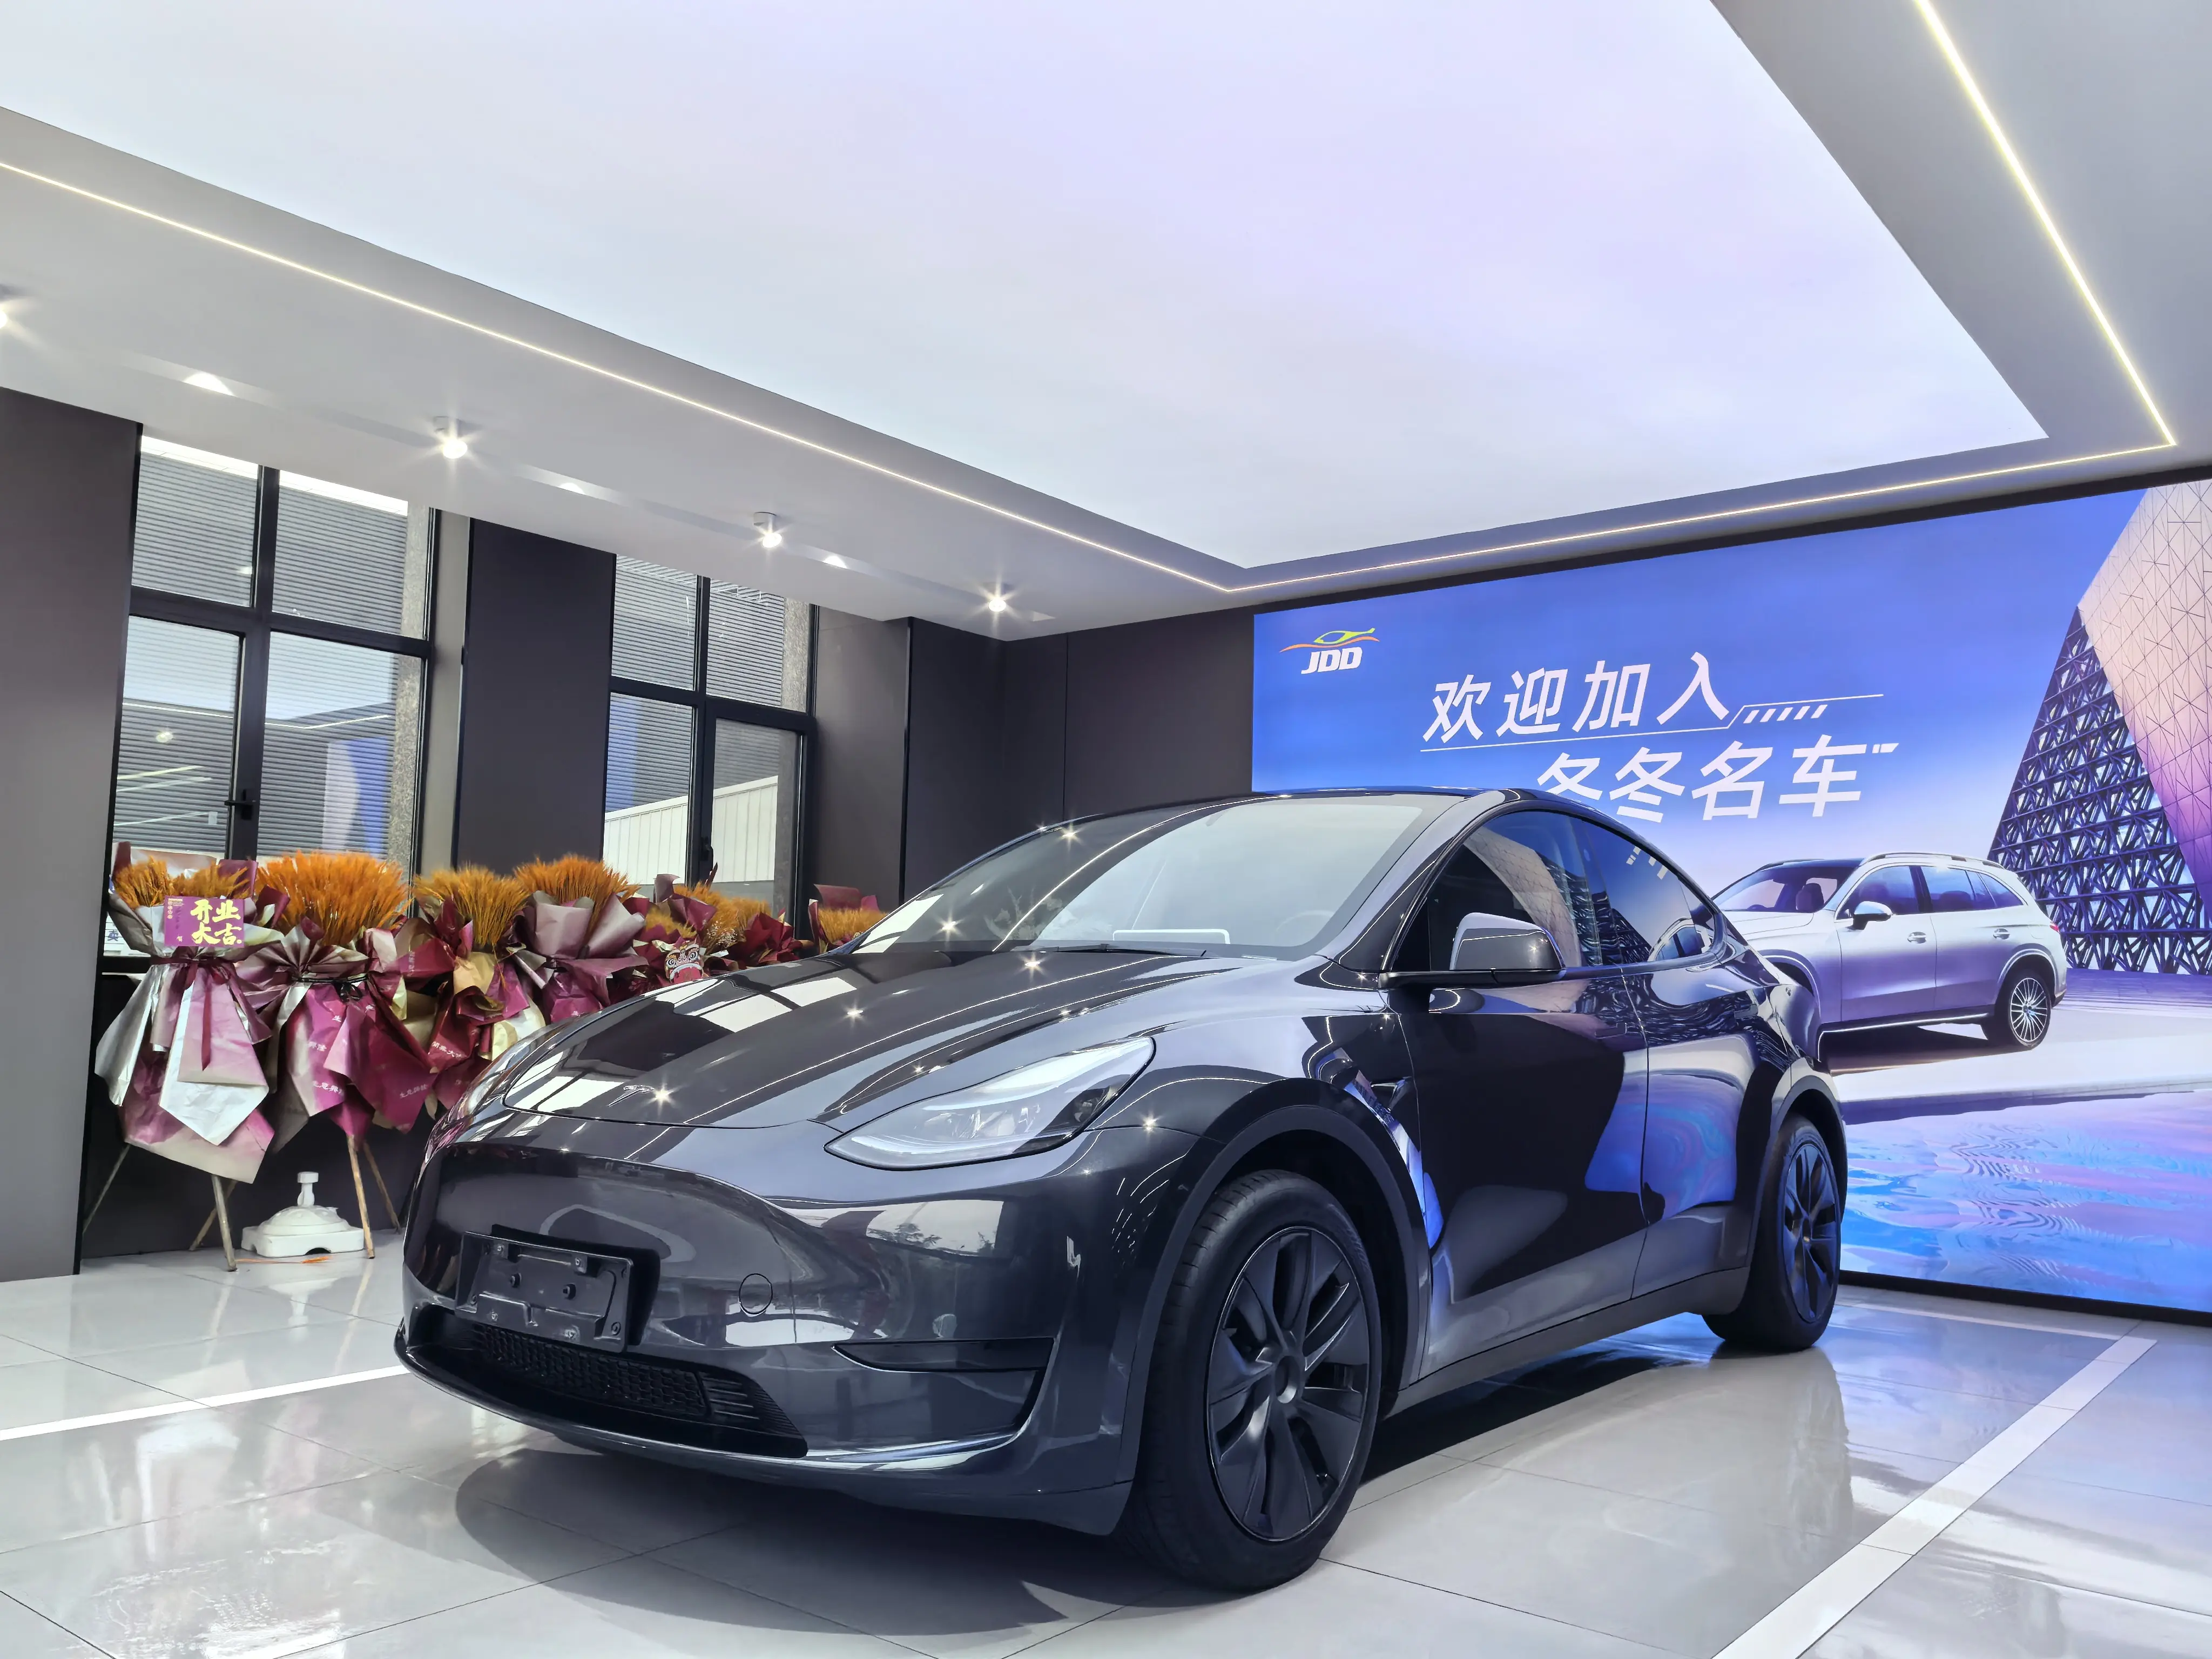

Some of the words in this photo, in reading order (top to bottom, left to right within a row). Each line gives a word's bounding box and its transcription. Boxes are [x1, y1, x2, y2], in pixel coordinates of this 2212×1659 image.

[1301, 646, 1363, 675] JDD
[1422, 652, 1729, 744] 欢迎加入
[190, 899, 241, 924] 开业
